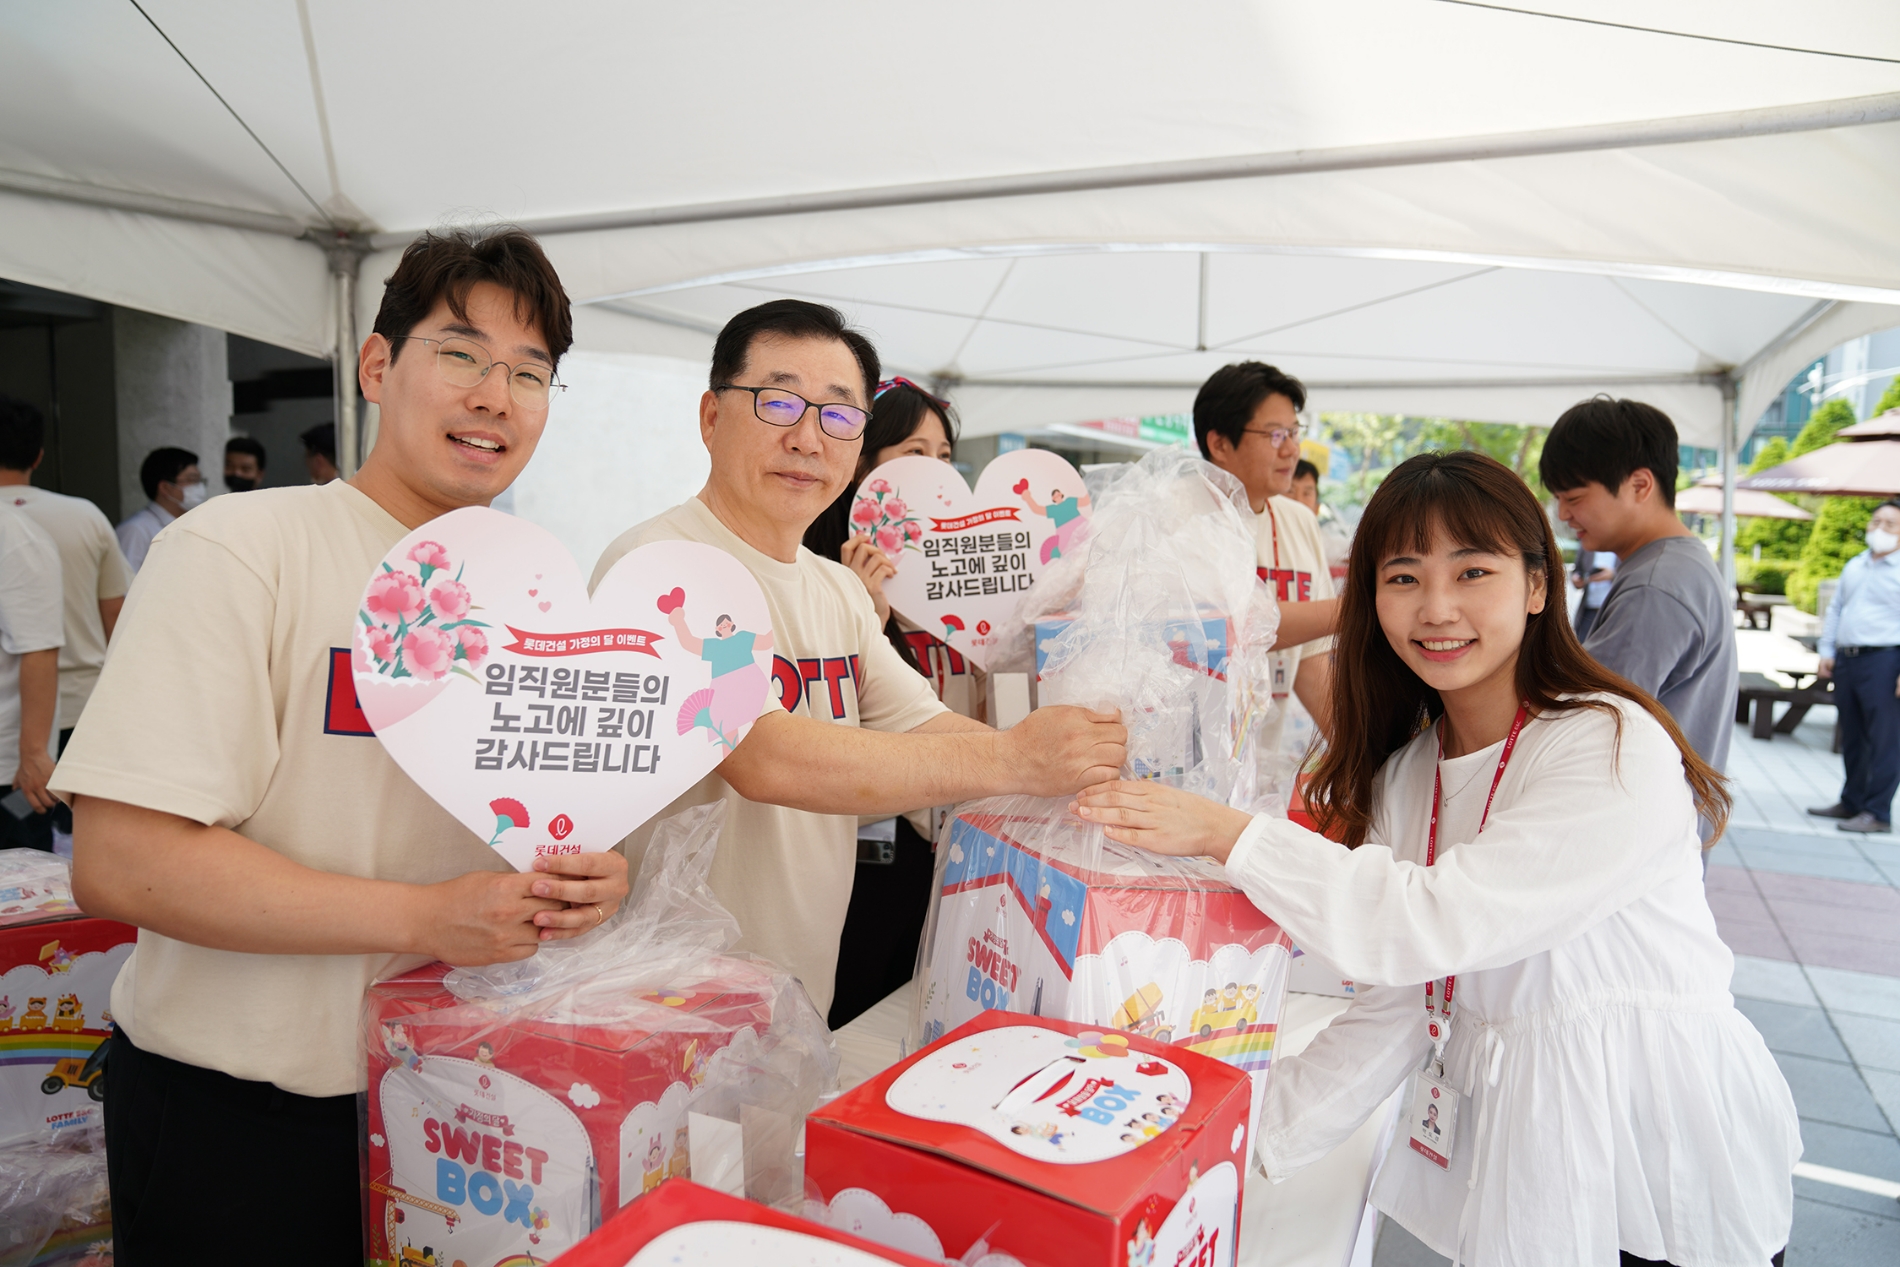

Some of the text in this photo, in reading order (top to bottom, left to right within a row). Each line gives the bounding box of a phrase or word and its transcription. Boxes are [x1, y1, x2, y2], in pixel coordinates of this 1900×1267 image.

[923, 531, 1031, 558] 임직원분들의
[931, 553, 1026, 578] 노고에 깊이
[926, 573, 1035, 601] 감사드립니다
[523, 634, 646, 651] 롯데건설 가정의 달 이벤트
[485, 663, 670, 705] 임직원분들의
[490, 702, 655, 739] 노고에 깊이
[1506, 731, 1517, 750] LOTTE
[474, 738, 661, 774] 감사드립니다
[535, 844, 582, 857] 롯데건설
[967, 936, 1022, 993] SWEET
[46, 1111, 74, 1123] LOTTE
[468, 1108, 501, 1127] 가정의 달
[1078, 1084, 1141, 1125] BOX
[51, 1116, 88, 1130] FAMILY
[423, 1117, 549, 1185] SWEET
[436, 1157, 534, 1229] BOX
